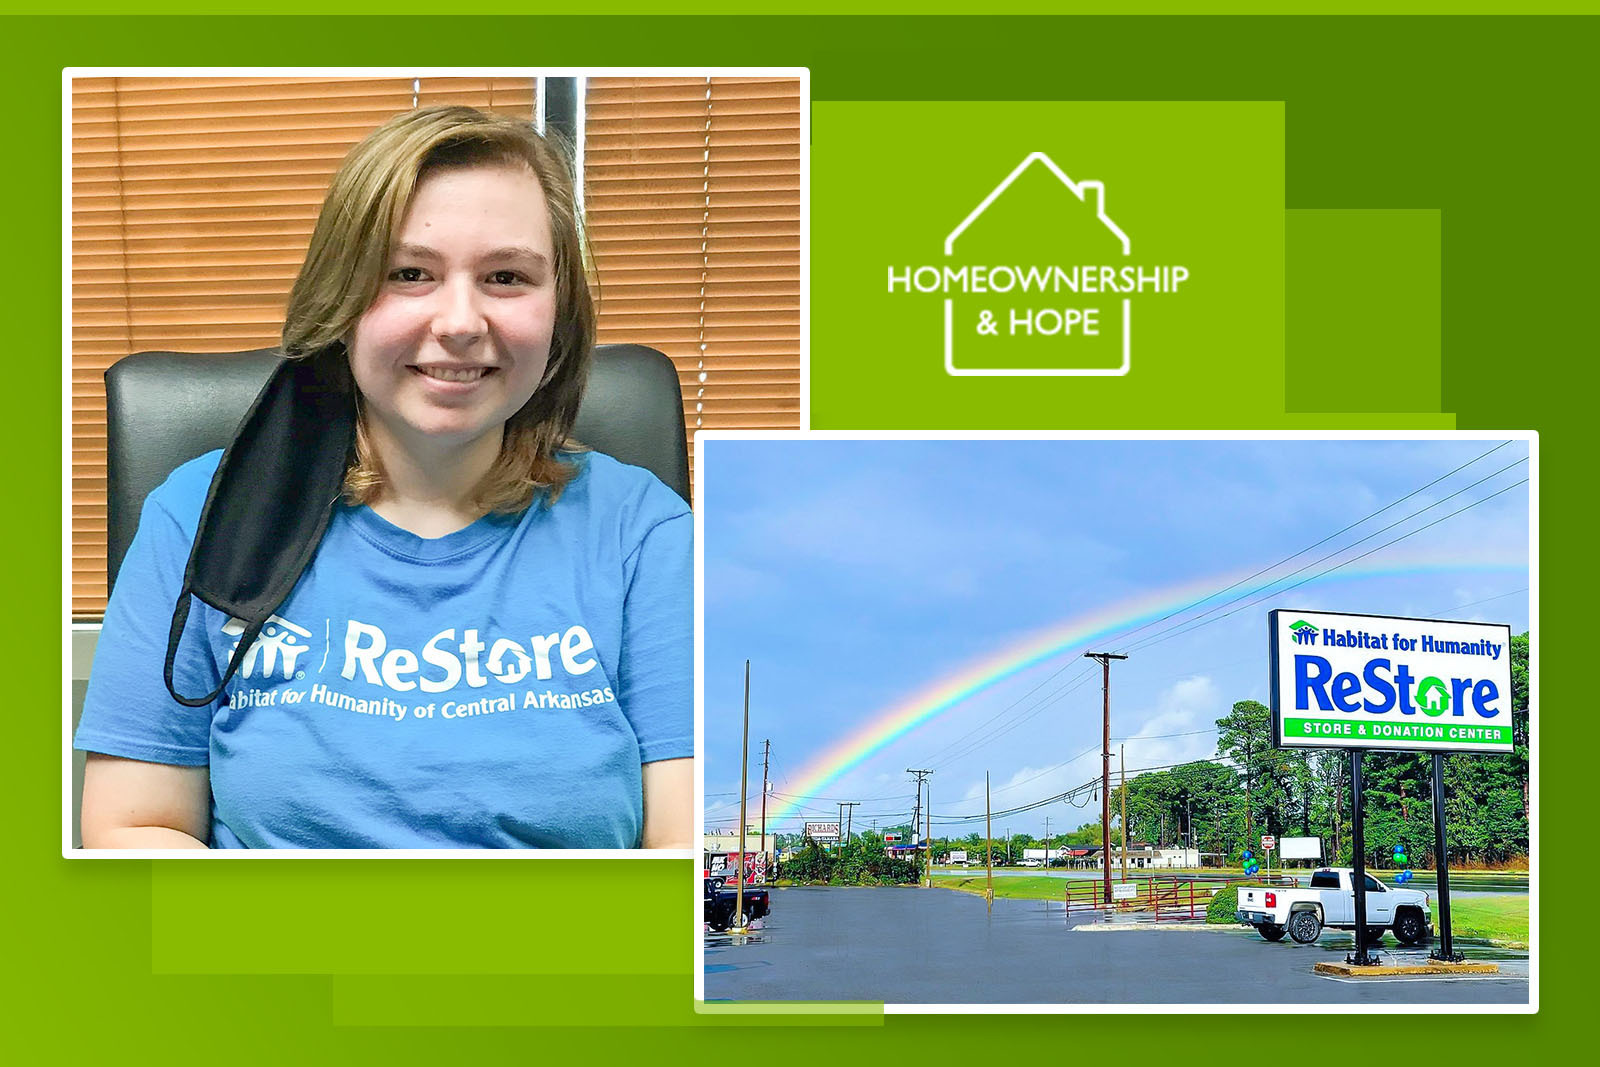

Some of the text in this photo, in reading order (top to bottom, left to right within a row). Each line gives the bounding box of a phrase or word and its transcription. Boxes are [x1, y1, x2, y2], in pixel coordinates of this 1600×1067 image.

[341, 619, 597, 693] ReStore
[1322, 628, 1502, 660] Habitat for Humanity
[229, 684, 614, 722] abitat for Humanity of Central Arkansas
[1293, 654, 1500, 719] ReStore
[1303, 721, 1502, 740] STORE & DONATION CENTER
